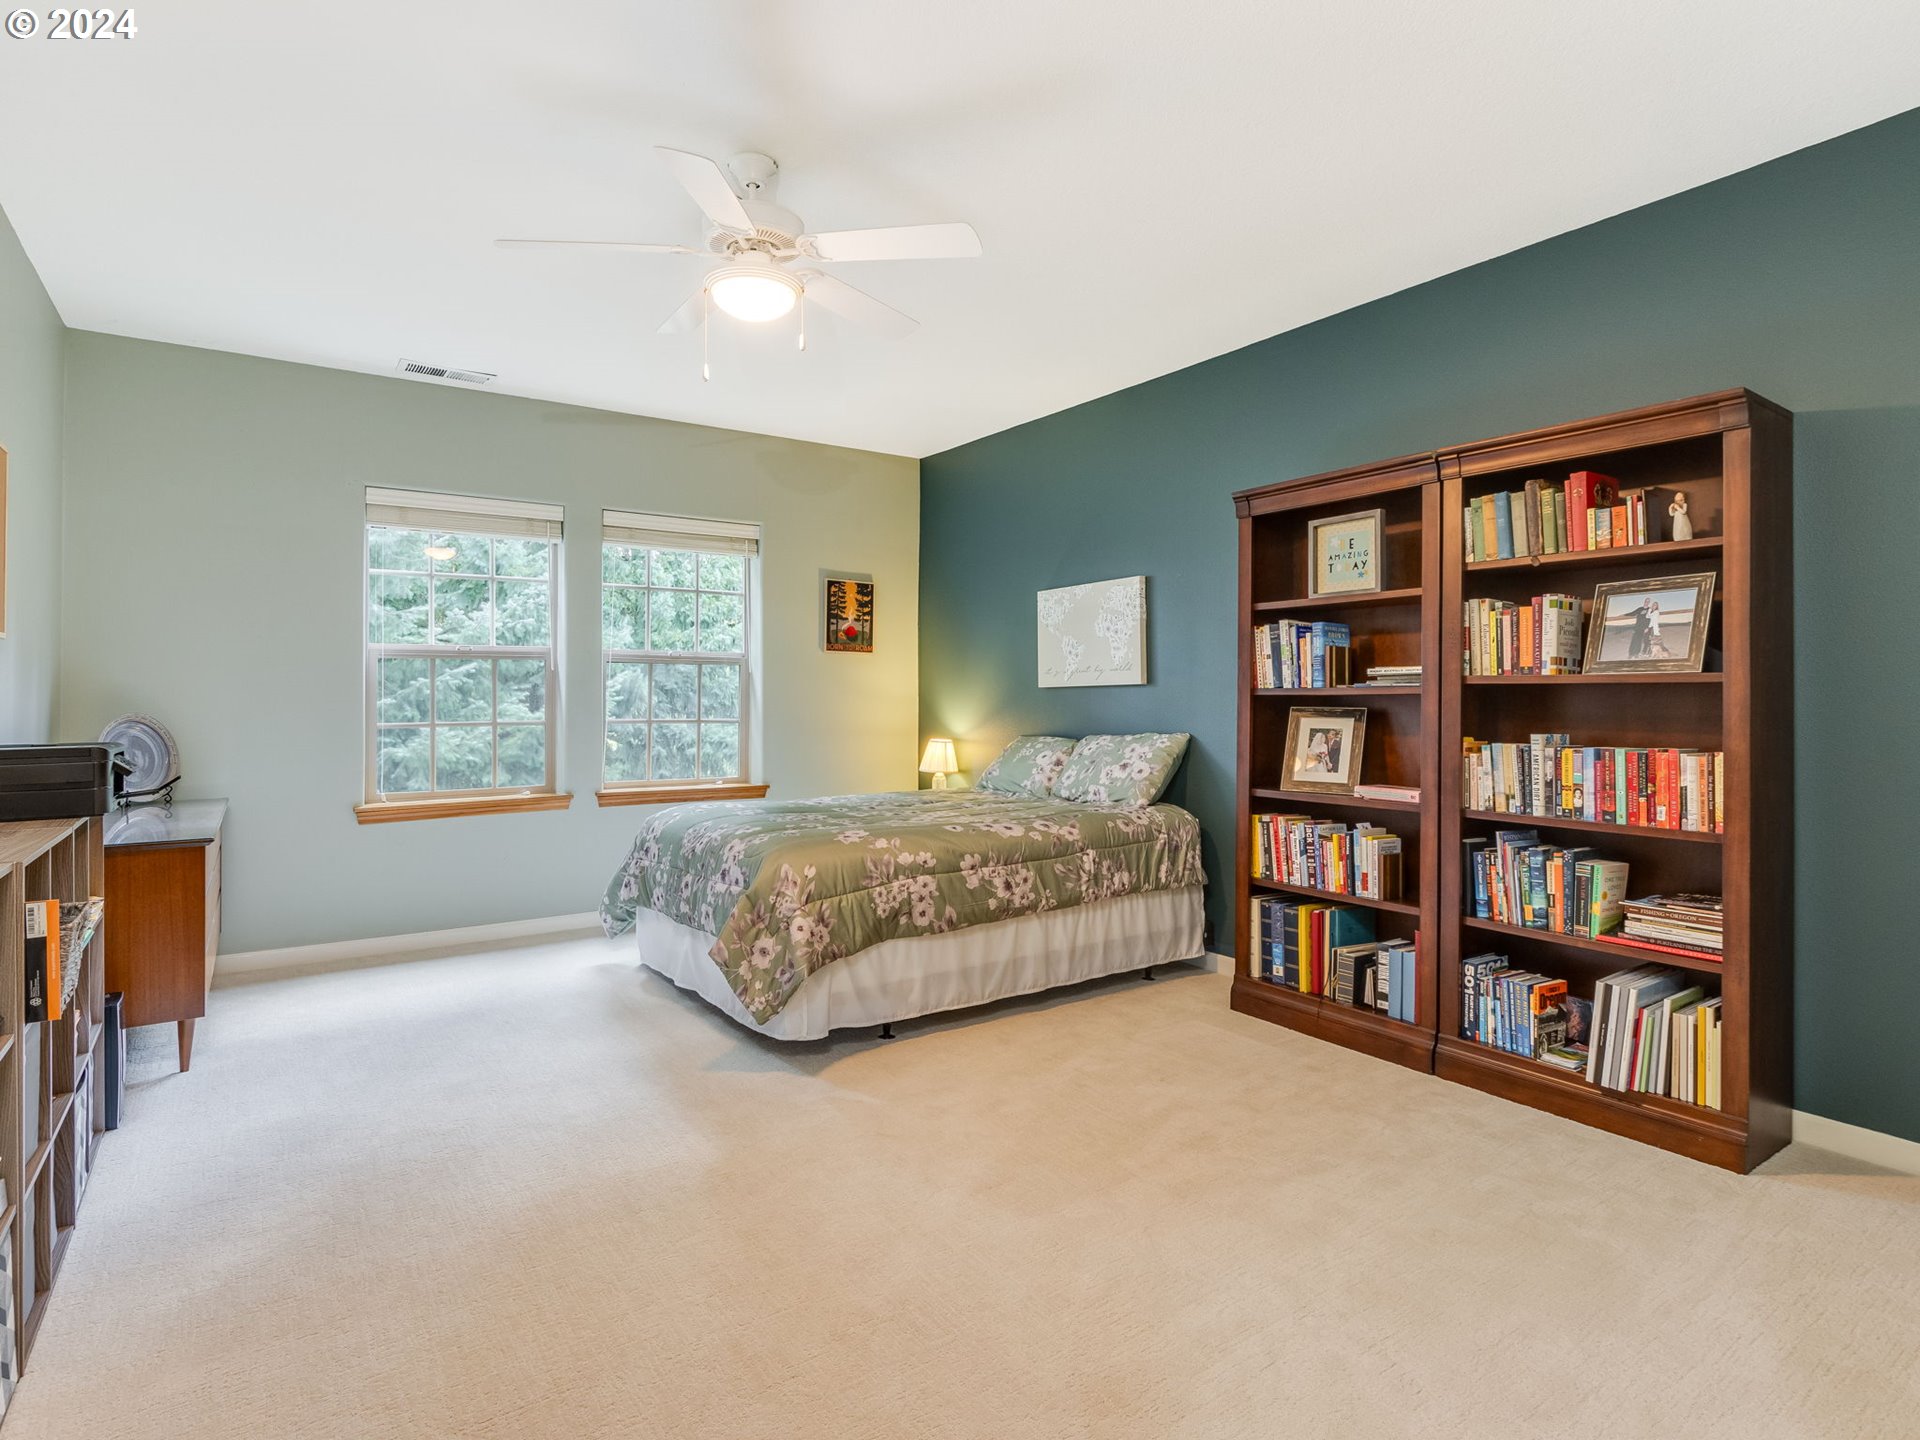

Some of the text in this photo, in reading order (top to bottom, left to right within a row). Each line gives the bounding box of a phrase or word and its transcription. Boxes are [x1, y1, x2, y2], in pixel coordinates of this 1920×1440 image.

[1328, 550, 1369, 561] AMAZING
[1328, 560, 1368, 574] TODAY
[1532, 754, 1541, 801] AMERICAN DIRT
[1640, 908, 1666, 918] FISHING
[1669, 912, 1698, 923] OREGON
[1378, 950, 1390, 994] NEW YORK CITY
[1464, 963, 1475, 995] 501
